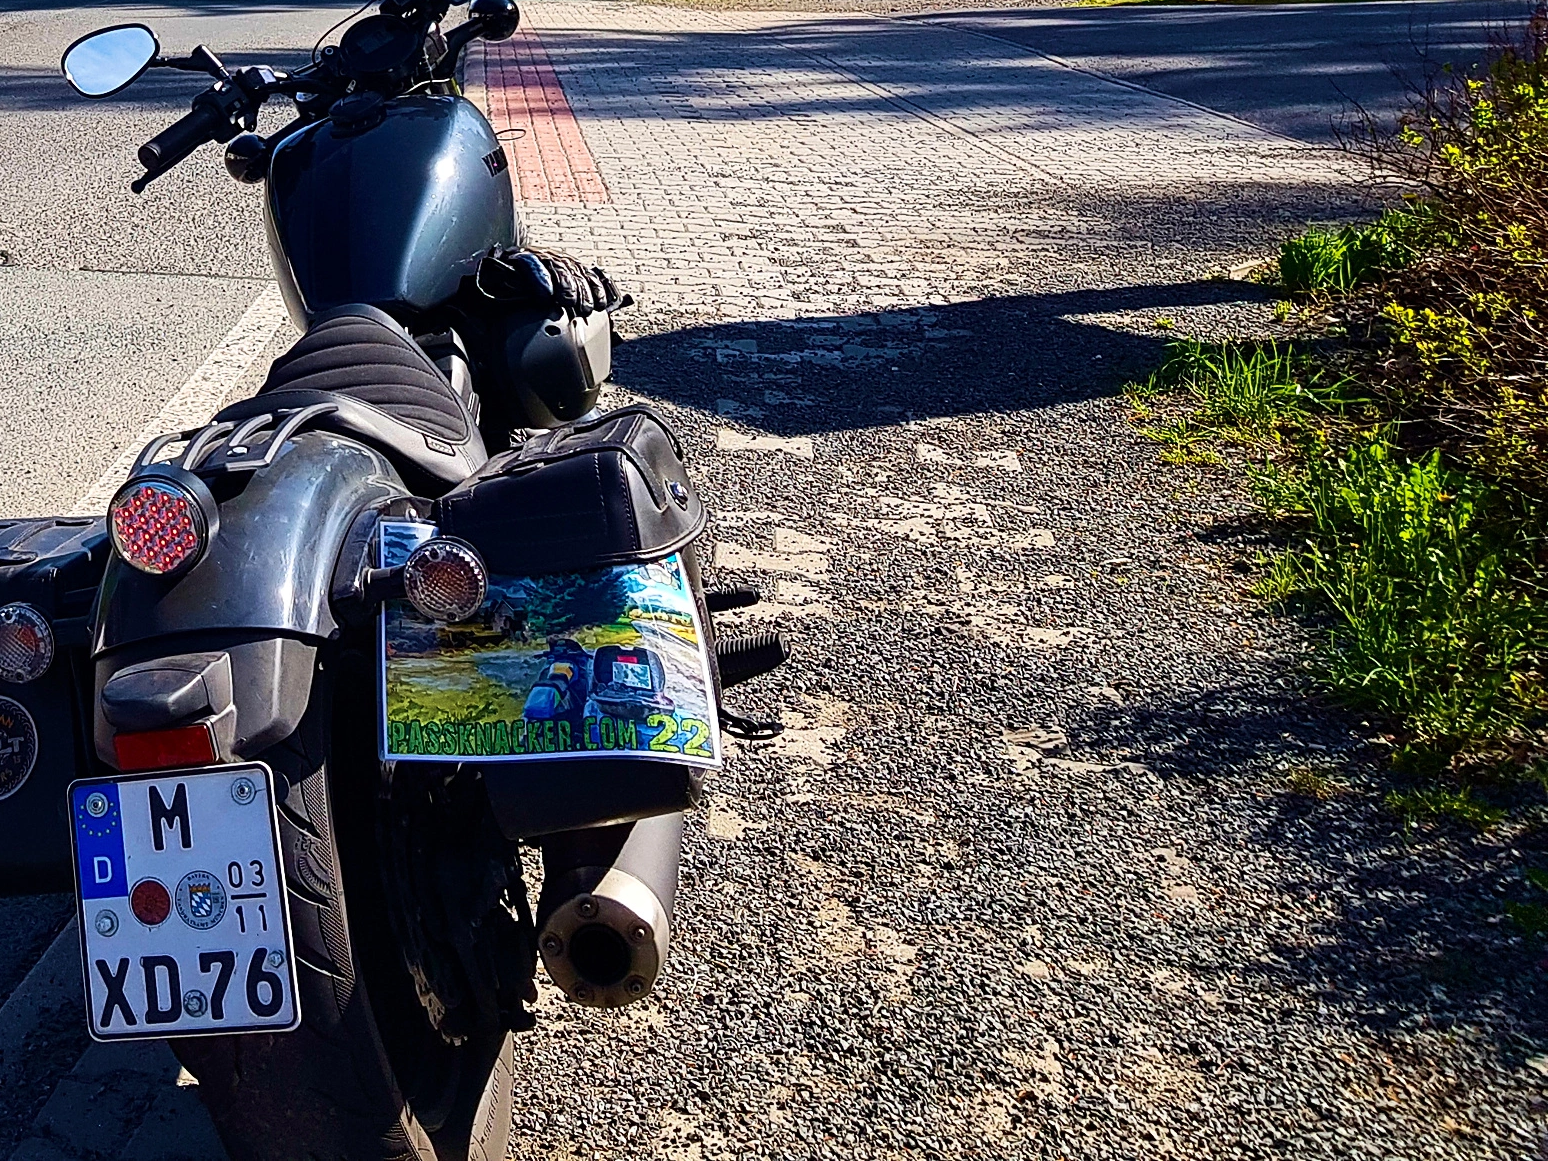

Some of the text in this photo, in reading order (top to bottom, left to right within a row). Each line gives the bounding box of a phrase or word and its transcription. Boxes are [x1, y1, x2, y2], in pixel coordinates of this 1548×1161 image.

[390, 714, 712, 758] PASSKNACKER.COM 22
[148, 782, 193, 852] M
[93, 855, 113, 884] D
[227, 860, 265, 888] 03
[235, 904, 268, 933] 11
[95, 947, 284, 1028] XD 76
